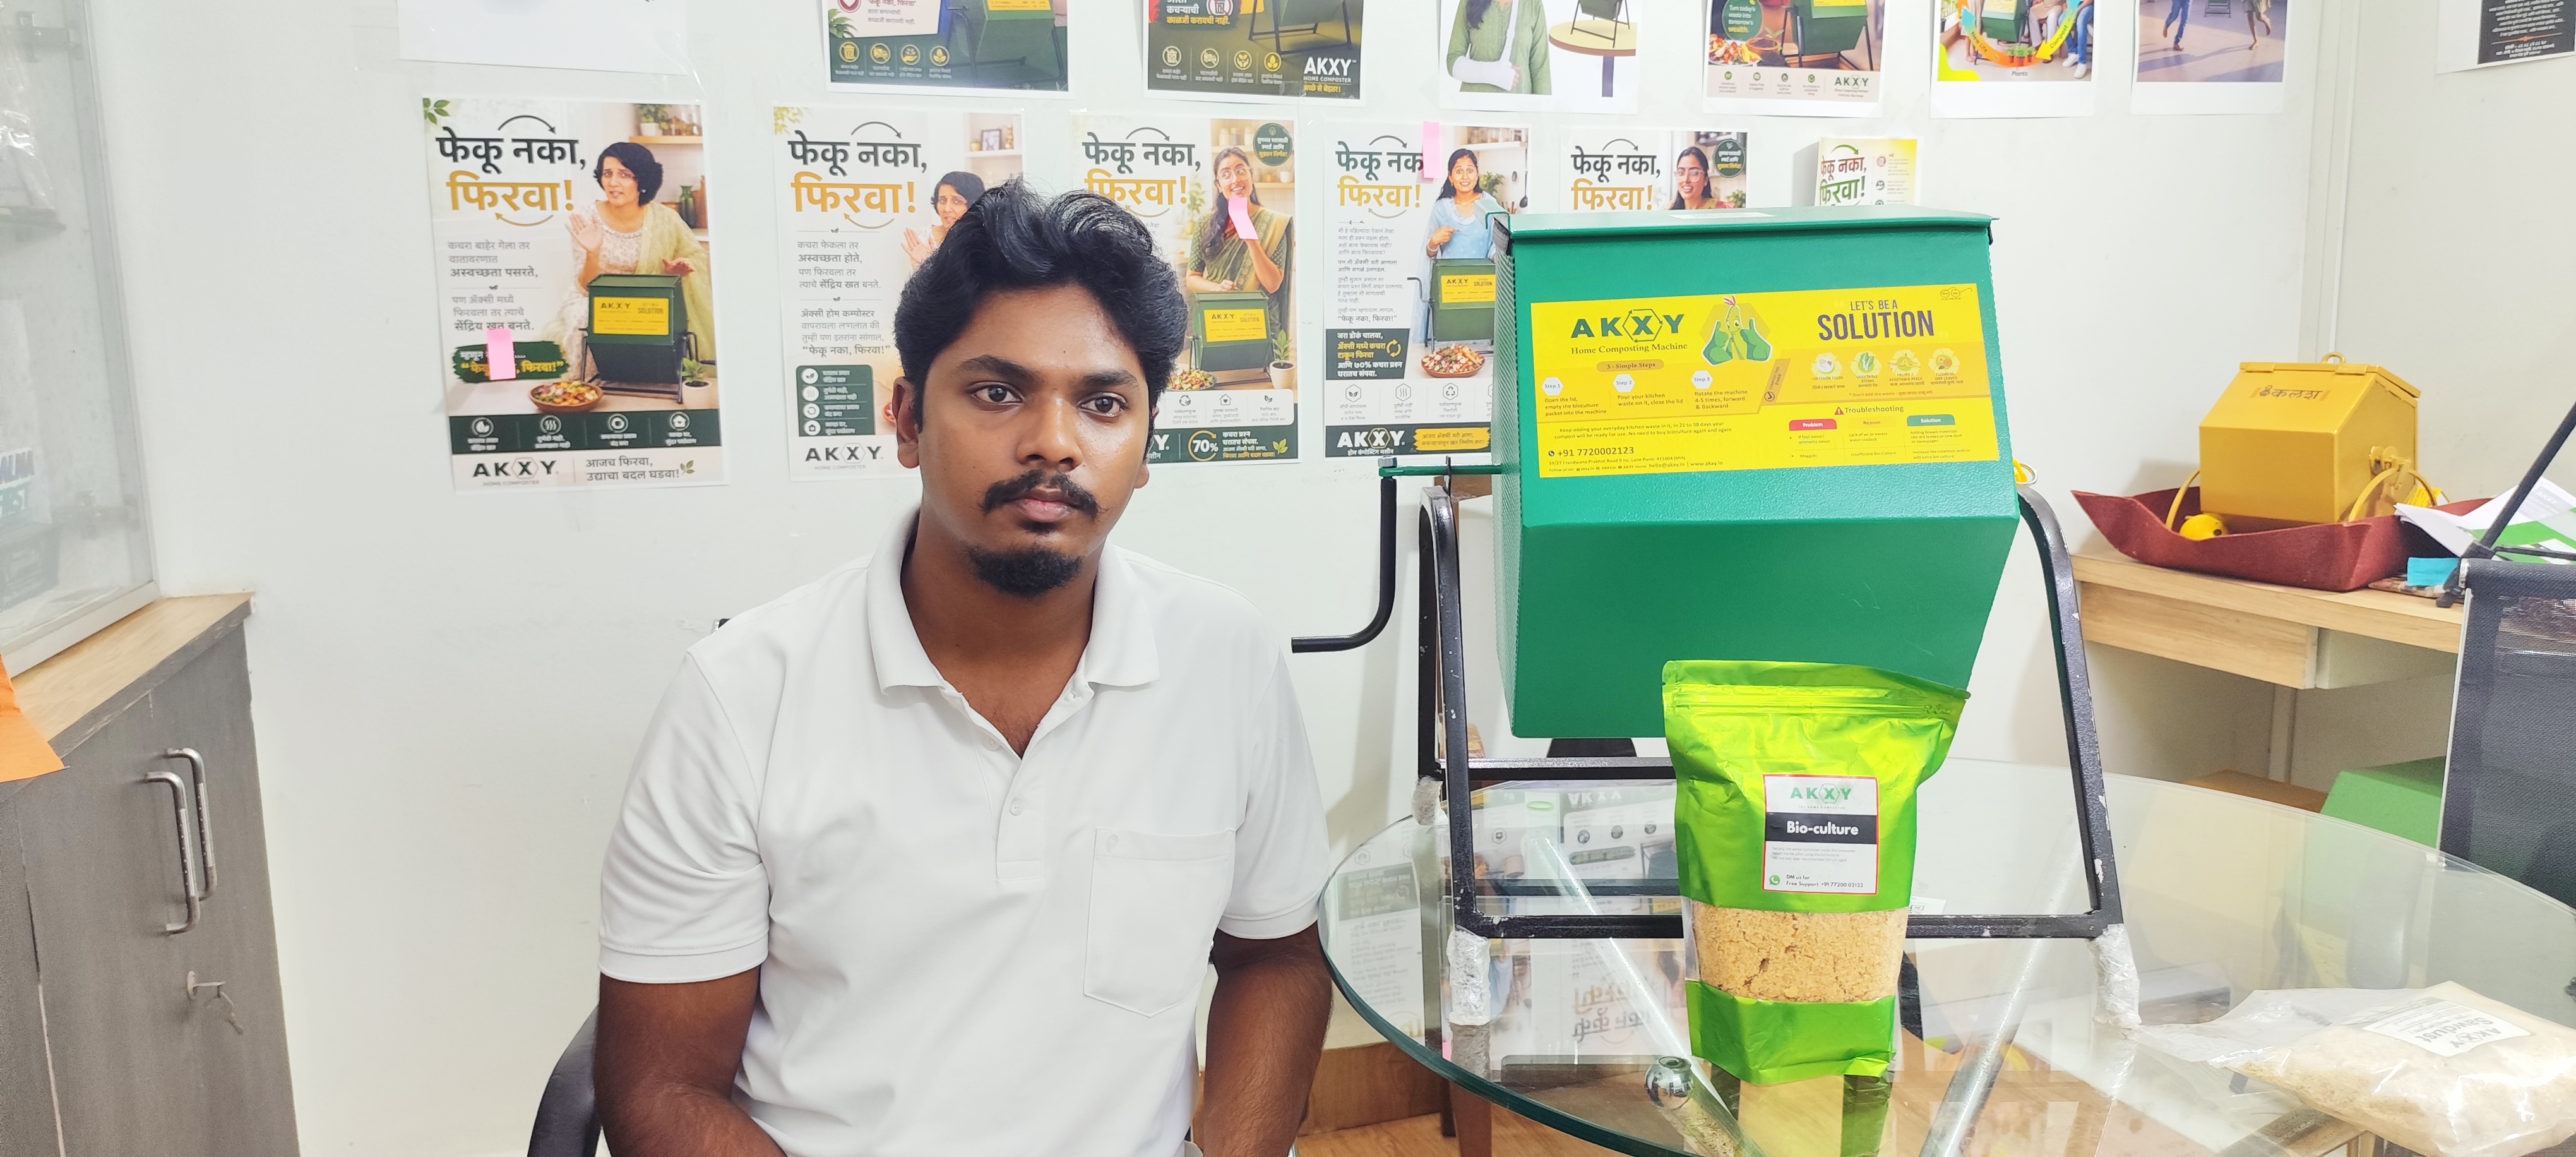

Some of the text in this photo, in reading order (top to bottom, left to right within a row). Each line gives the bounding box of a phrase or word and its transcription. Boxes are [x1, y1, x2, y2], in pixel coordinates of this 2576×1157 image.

[2050, 25, 2068, 49] Compost
[1834, 77, 1869, 87] AKXY
[436, 126, 587, 174] फेकू नका,
[787, 130, 927, 177] फेकू नका,
[1082, 132, 1201, 174] फेकू नका,
[1335, 141, 1382, 181] फेकू
[1571, 145, 1661, 183] फेकू नका,
[1821, 155, 1866, 181] फेकू नका,
[446, 171, 574, 212] फिरवा!
[790, 171, 915, 213] फिरवा!
[1084, 168, 1187, 205] फिरवा!
[1337, 175, 1421, 208] फिरवा!
[1571, 178, 1653, 210] फिरवा!
[1820, 176, 1866, 205] फिरवा!
[821, 239, 847, 249] फेकला
[844, 252, 862, 263] होते,
[450, 265, 538, 278] अस्वच्छता पसरते,
[814, 267, 844, 276] फिरवला
[1850, 299, 1898, 311] LET'S BE A
[1571, 314, 1685, 338] AKXY
[1818, 310, 1935, 341] SOLUTION
[830, 347, 852, 356] नका,
[805, 446, 882, 462] AKXY
[1192, 440, 1219, 452] 70%
[1577, 447, 1634, 456] 7720002123
[472, 460, 556, 478] AKXY
[1790, 787, 1852, 800] AKXY
[1787, 821, 1859, 835] Bio-culture
[2414, 1017, 2494, 1043] Sawdust
